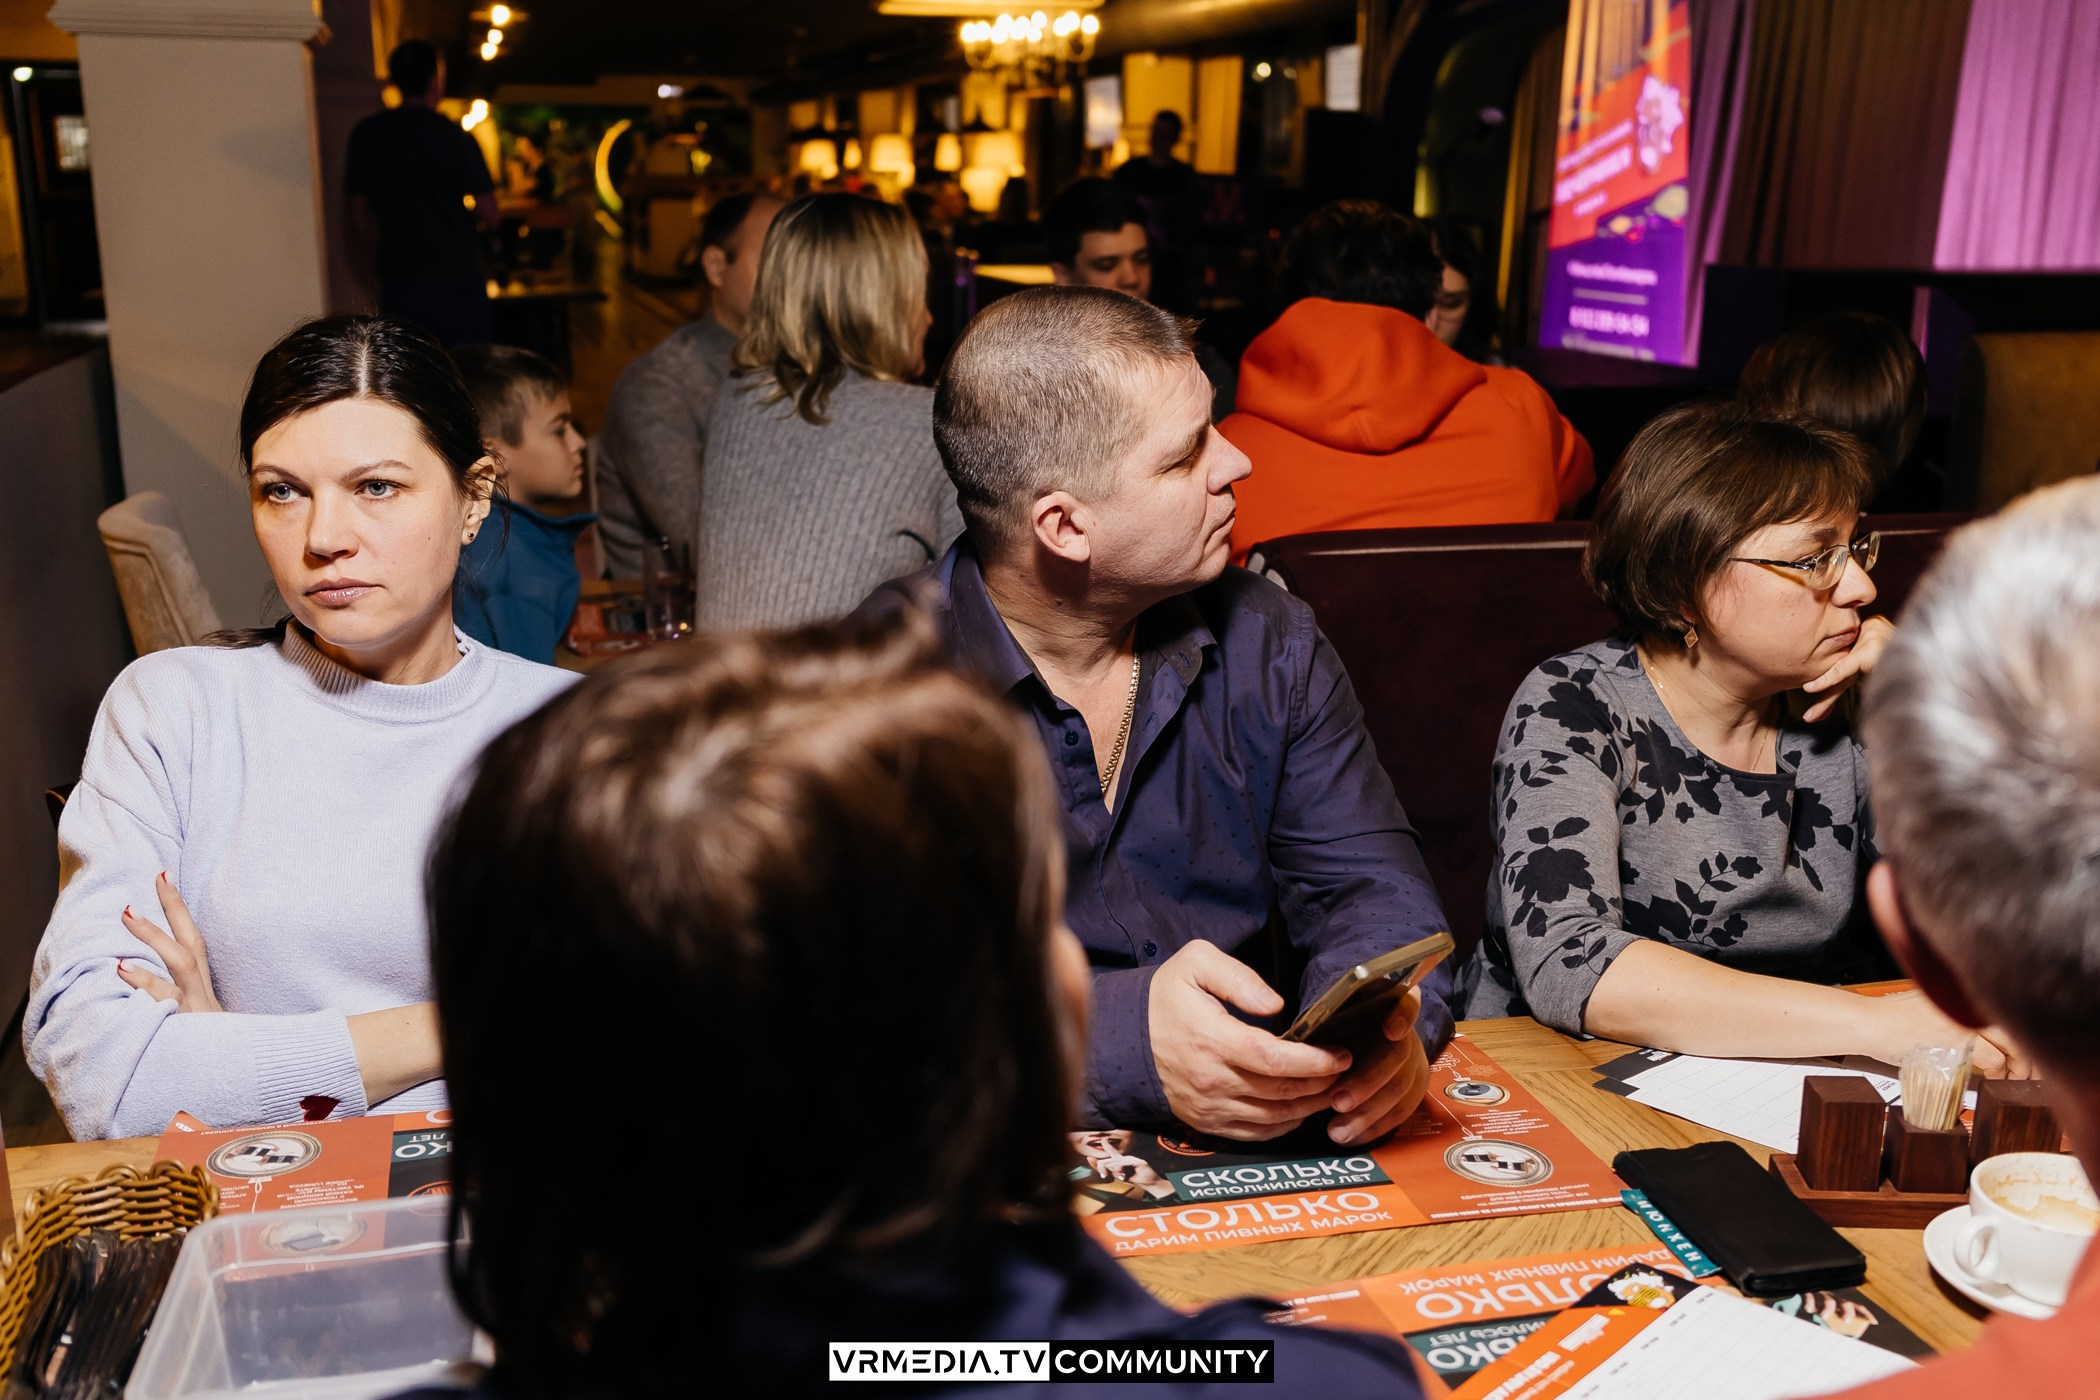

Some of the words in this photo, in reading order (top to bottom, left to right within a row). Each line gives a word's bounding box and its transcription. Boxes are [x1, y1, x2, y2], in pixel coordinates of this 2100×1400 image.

[408, 1133, 446, 1143] ЛЕТ
[1182, 1157, 1376, 1188] СКОЛЬКО
[1189, 1178, 1335, 1198] ИСПОЛНИЛОСЬ
[1339, 1173, 1372, 1185] ЛЕТ
[1105, 1192, 1380, 1238] СТОЛЬКО
[1115, 1232, 1197, 1252] ДАРИМ
[1204, 1221, 1304, 1242] ПИВНЫХ
[1311, 1210, 1393, 1230] МАРОК
[1492, 1259, 1587, 1282] ПИВНЫХ
[1591, 1249, 1672, 1269] ДАРИМ
[1398, 1274, 1482, 1295] МАРОК
[1429, 1331, 1464, 1347] ЛЕТ
